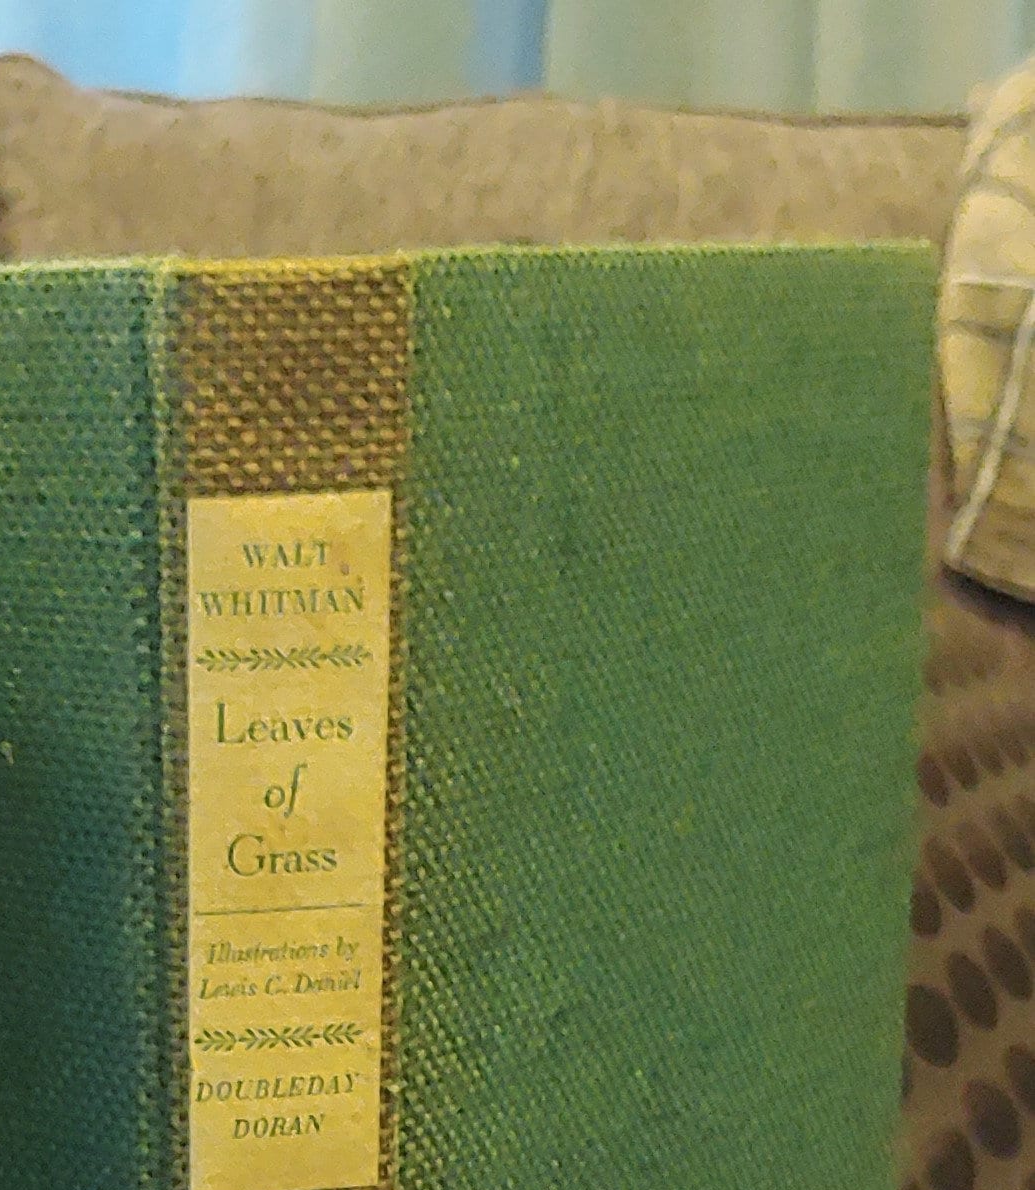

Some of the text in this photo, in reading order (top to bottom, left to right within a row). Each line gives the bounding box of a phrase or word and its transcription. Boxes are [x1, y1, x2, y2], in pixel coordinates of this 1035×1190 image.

[241, 538, 332, 568] WALT
[197, 587, 364, 617] WHITMAN
[217, 701, 354, 744] Leaves
[263, 762, 308, 819] of
[227, 833, 338, 877] Grass
[206, 936, 360, 965] Illustrations by
[198, 978, 257, 1000] Lewis
[295, 970, 362, 995] Daniel
[195, 1071, 362, 1103] DOUBLEDAY
[232, 1113, 326, 1140] DORAN
